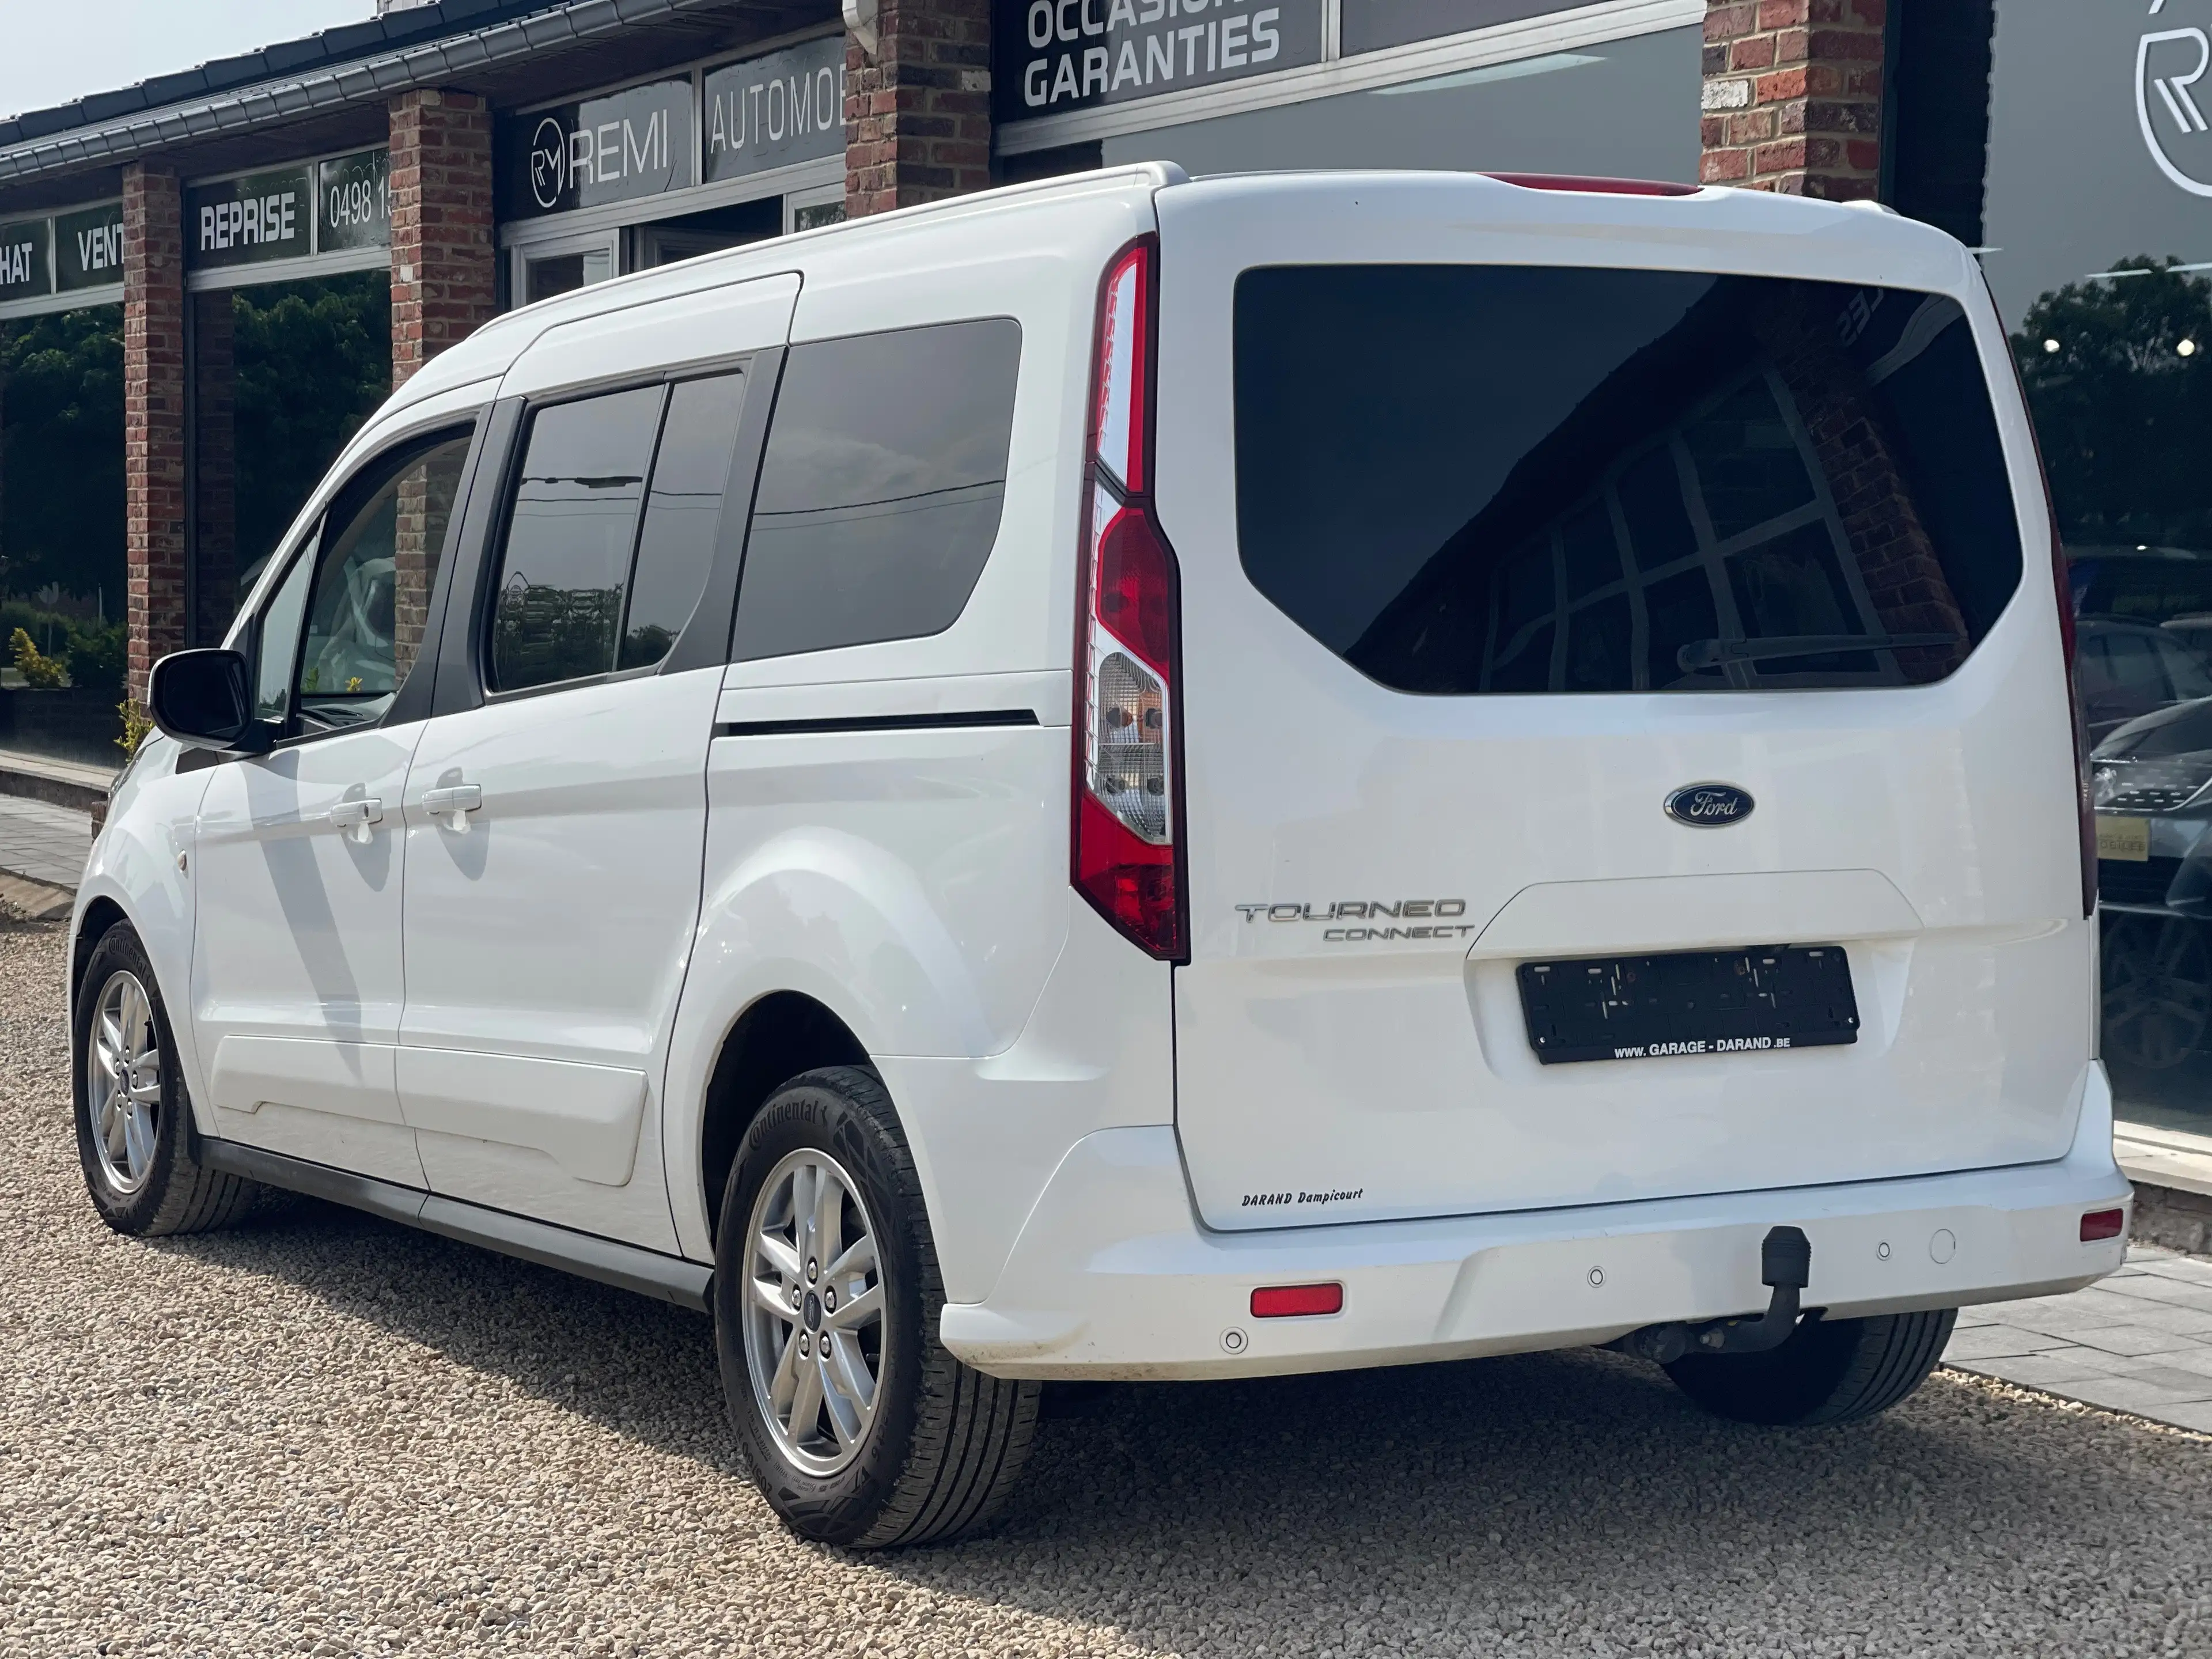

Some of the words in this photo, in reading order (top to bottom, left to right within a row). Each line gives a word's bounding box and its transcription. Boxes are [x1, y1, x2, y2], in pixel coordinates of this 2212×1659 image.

[1024, 7, 1279, 107] GARANTIES
[569, 109, 667, 189] REMI
[201, 192, 295, 251] REPRISE
[330, 179, 372, 228] 0498
[1690, 791, 1738, 816] Ford
[1234, 899, 1466, 923] TOURNEO
[1323, 924, 1475, 942] CONNECT
[1649, 1040, 1706, 1055] GARAGE
[1717, 1037, 1771, 1051] DARAND
[749, 1099, 819, 1151] Continental
[1241, 1193, 1292, 1207] DARAND
[1297, 1188, 1363, 1205] Dampicourt
